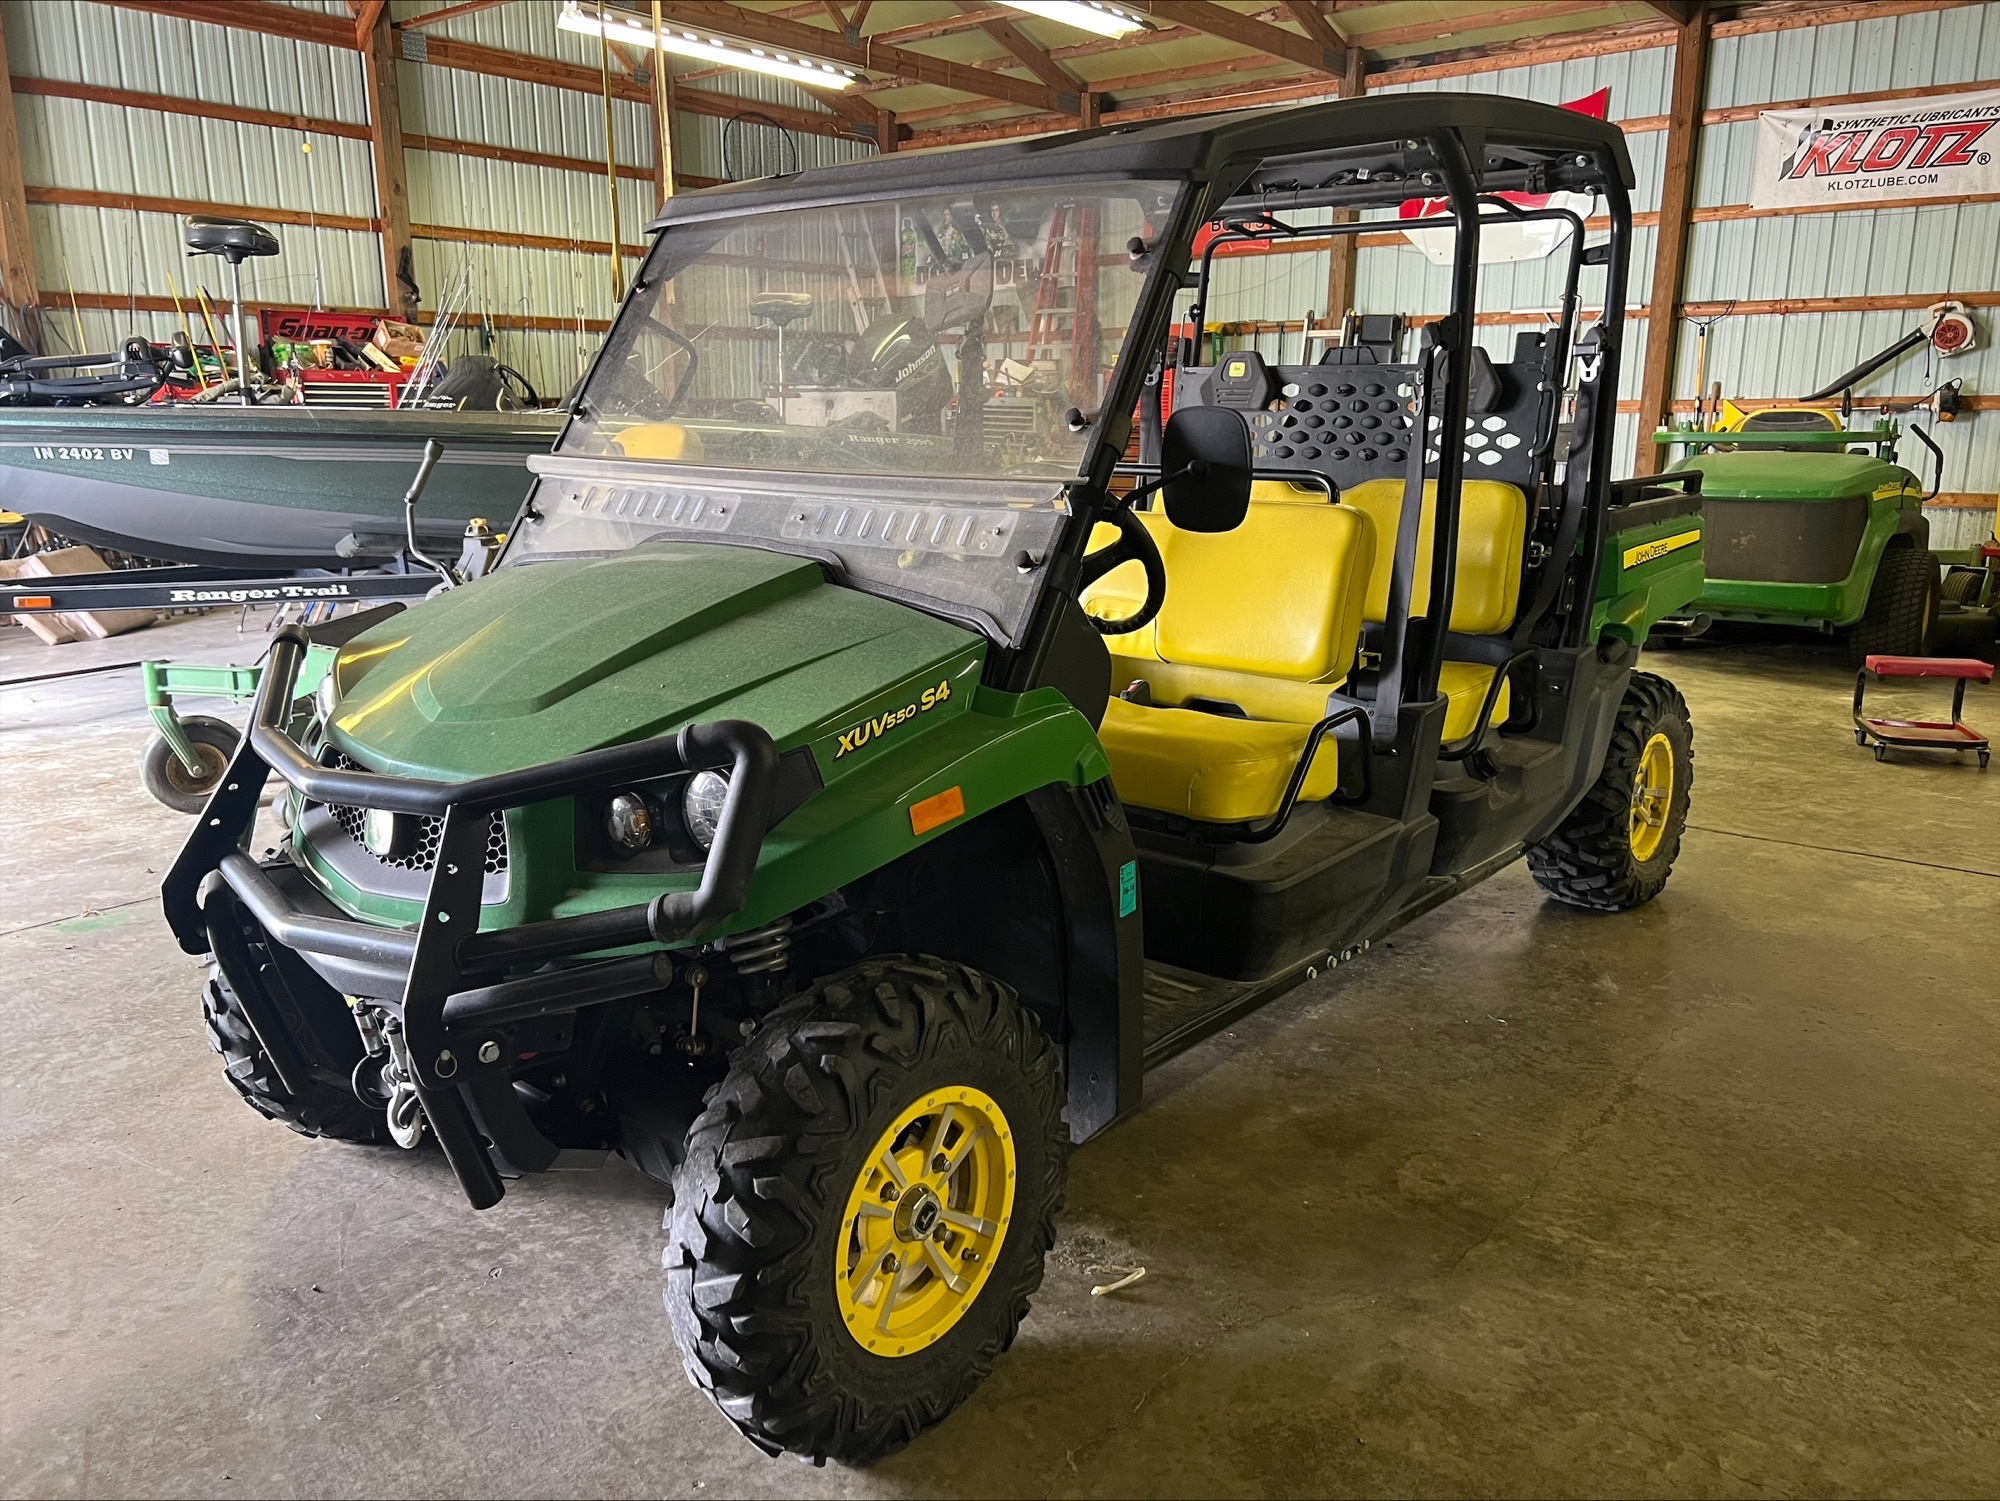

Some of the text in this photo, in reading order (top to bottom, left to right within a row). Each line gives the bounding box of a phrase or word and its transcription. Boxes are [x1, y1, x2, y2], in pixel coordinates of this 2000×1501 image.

[1833, 105, 2000, 131] SYNTHETIC LUBRICANTS
[1788, 119, 1999, 179] KLOTZ
[1827, 173, 1939, 191] KLOTZLUBE.COM
[895, 344, 937, 383] Johnson
[847, 434, 900, 446] Ranger
[33, 446, 134, 460] IN 2402 BV
[1634, 543, 1669, 564] JOHN DEERE
[170, 584, 350, 602] Ranger Trail
[920, 679, 951, 712] S4
